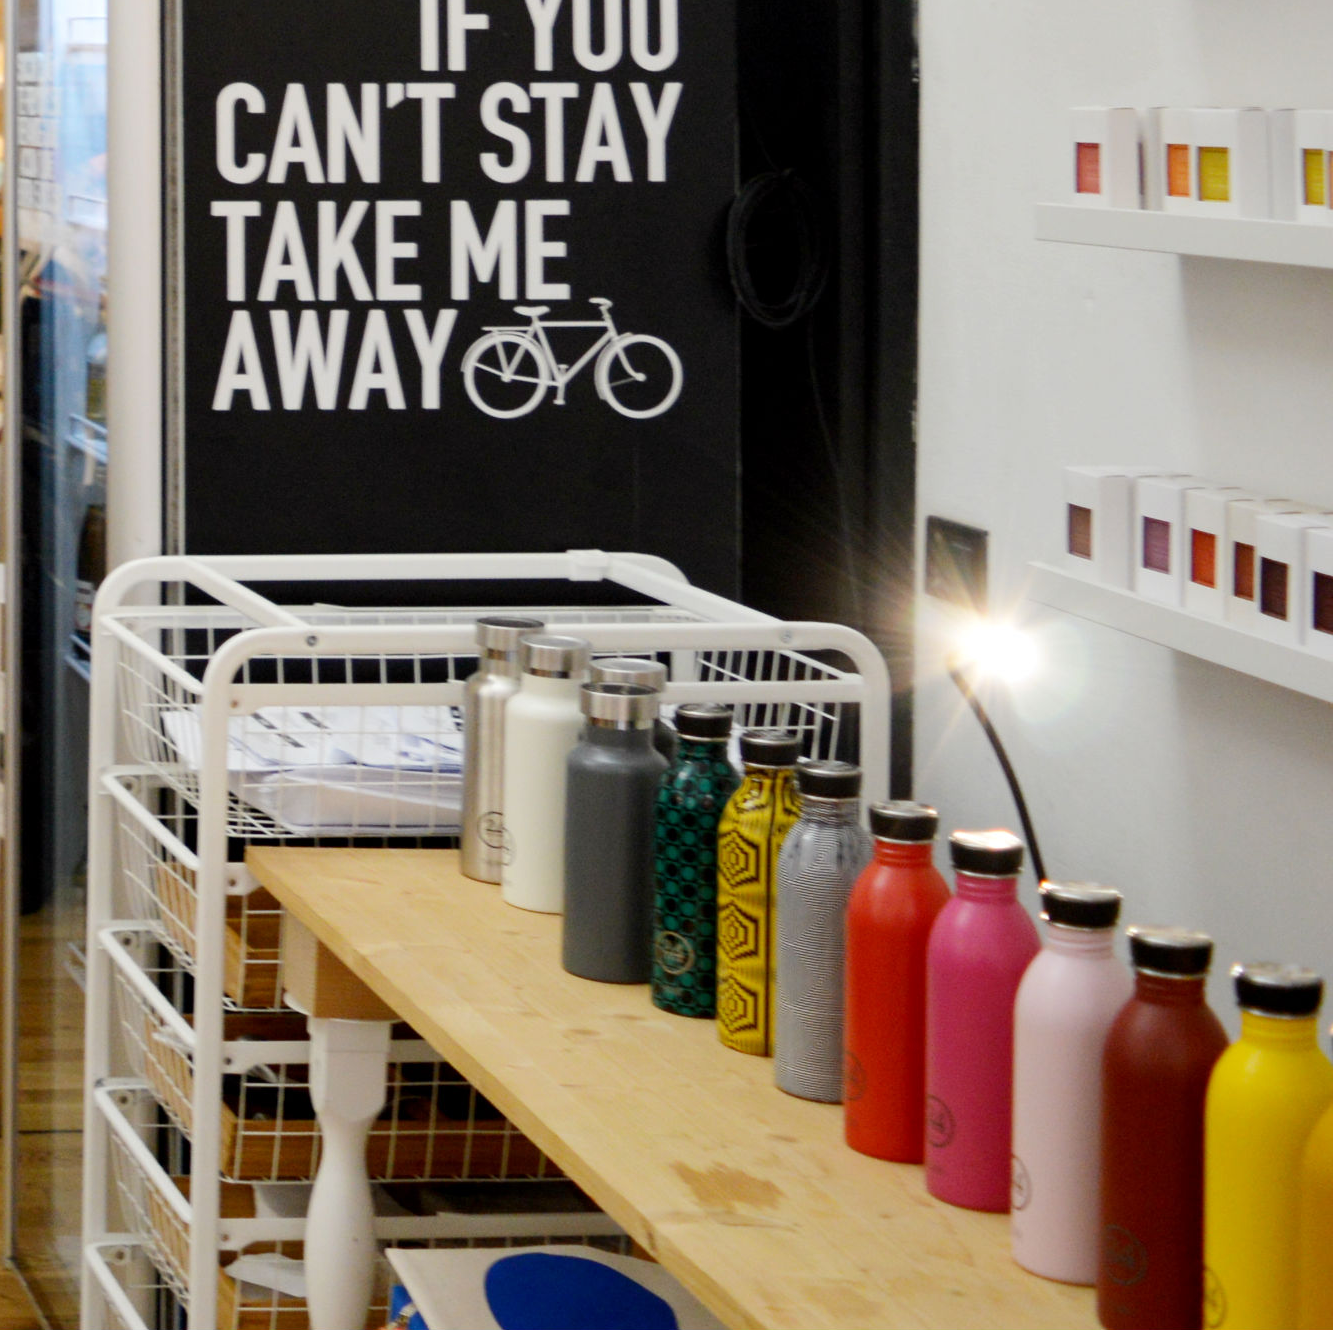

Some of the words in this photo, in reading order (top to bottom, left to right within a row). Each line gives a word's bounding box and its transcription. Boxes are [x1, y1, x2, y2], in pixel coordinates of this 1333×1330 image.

[215, 81, 456, 184] CAN'T
[479, 81, 683, 183] STAY
[210, 200, 422, 302] TAKE
[450, 199, 571, 301] ME
[211, 309, 458, 411] AWAY
